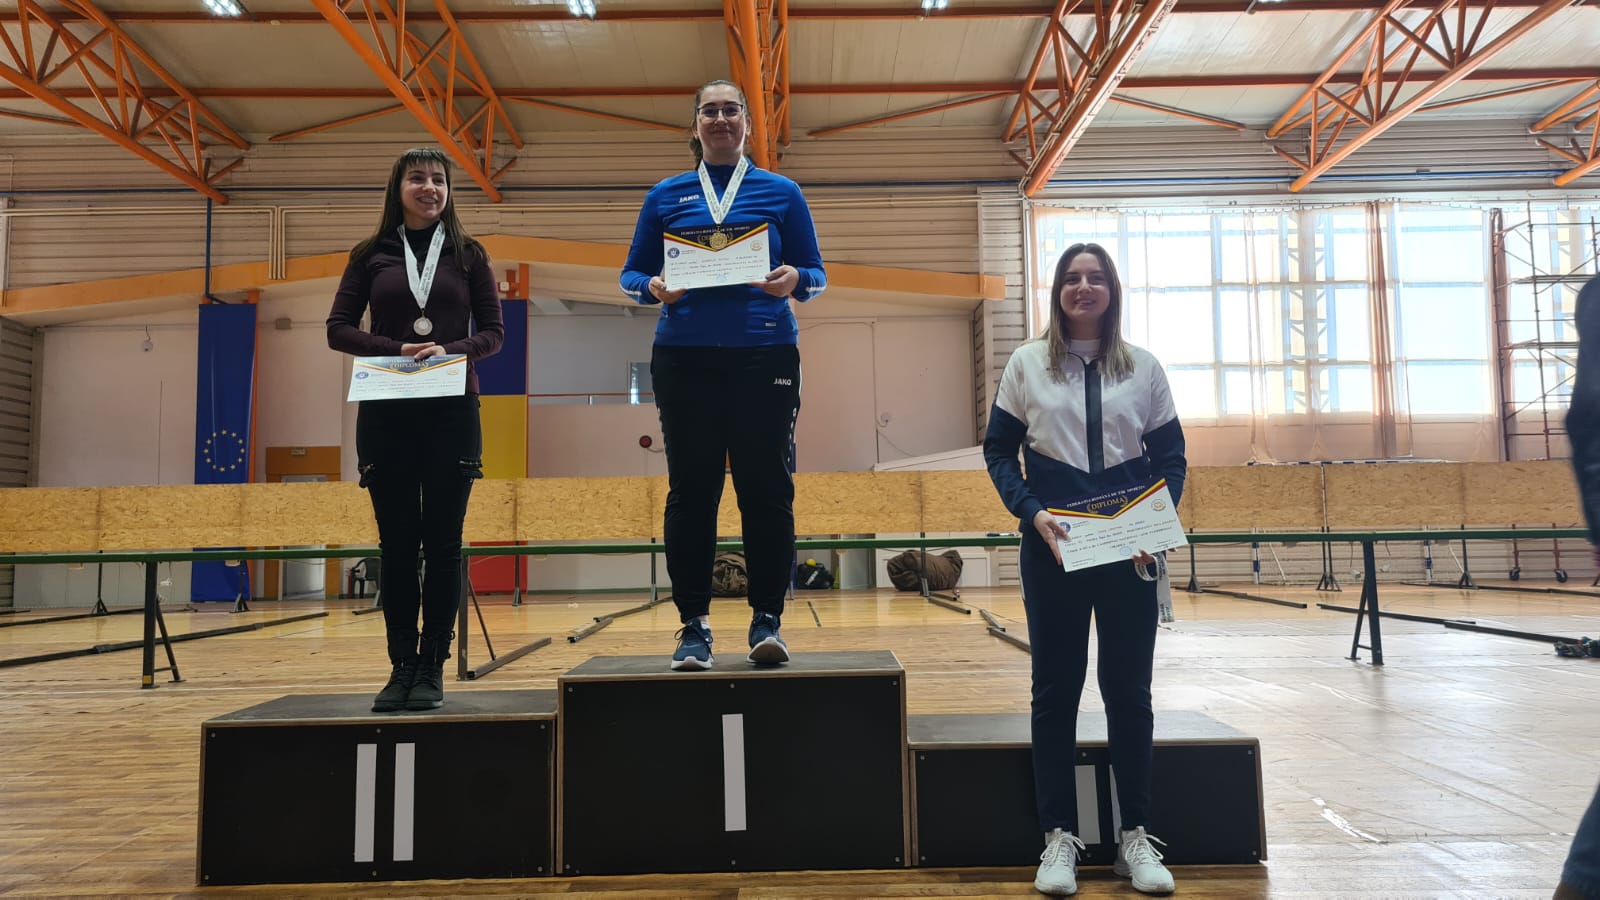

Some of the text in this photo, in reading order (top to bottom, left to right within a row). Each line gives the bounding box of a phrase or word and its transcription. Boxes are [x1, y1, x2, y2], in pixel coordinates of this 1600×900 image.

[679, 194, 700, 203] JAKO
[773, 378, 791, 386] JAKO
[1091, 497, 1124, 509] DIPLOMA
